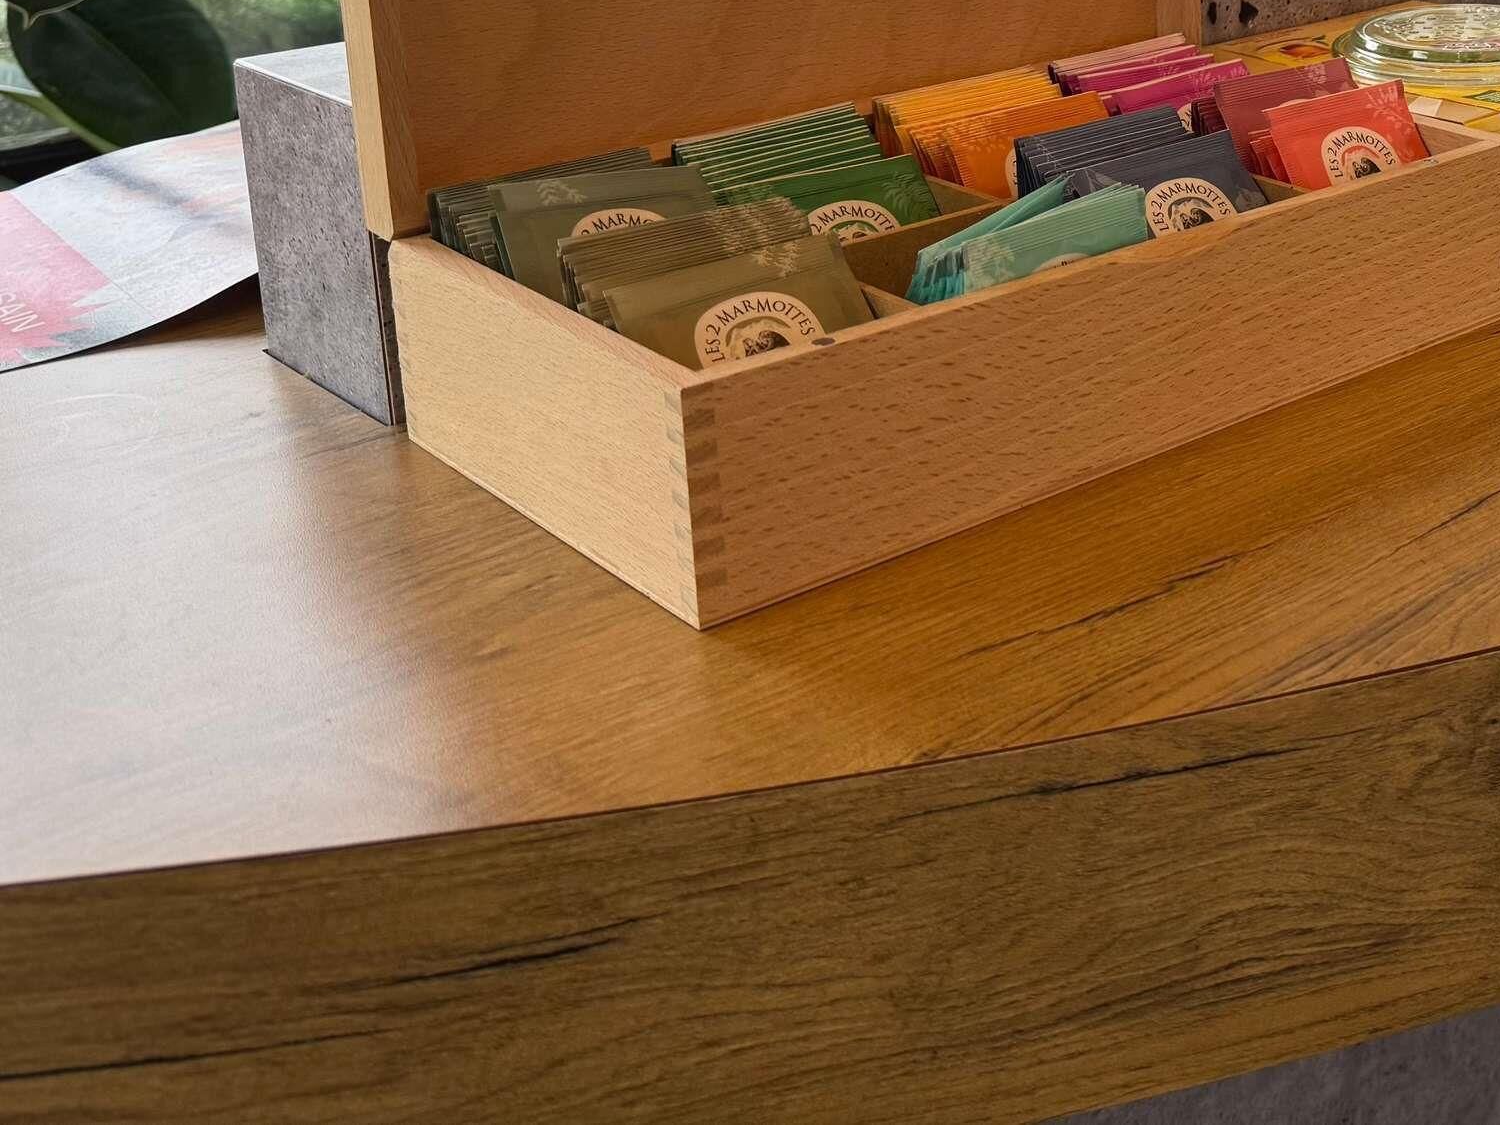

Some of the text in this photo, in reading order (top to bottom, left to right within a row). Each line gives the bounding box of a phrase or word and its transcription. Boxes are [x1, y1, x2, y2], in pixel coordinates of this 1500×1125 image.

[1327, 131, 1397, 178] LES 2 MARMOTTES
[817, 205, 896, 231] MARMOTT
[1150, 182, 1231, 231] LES 2 MARMOTTES
[704, 298, 816, 363] LES 2 MARMOTTES
